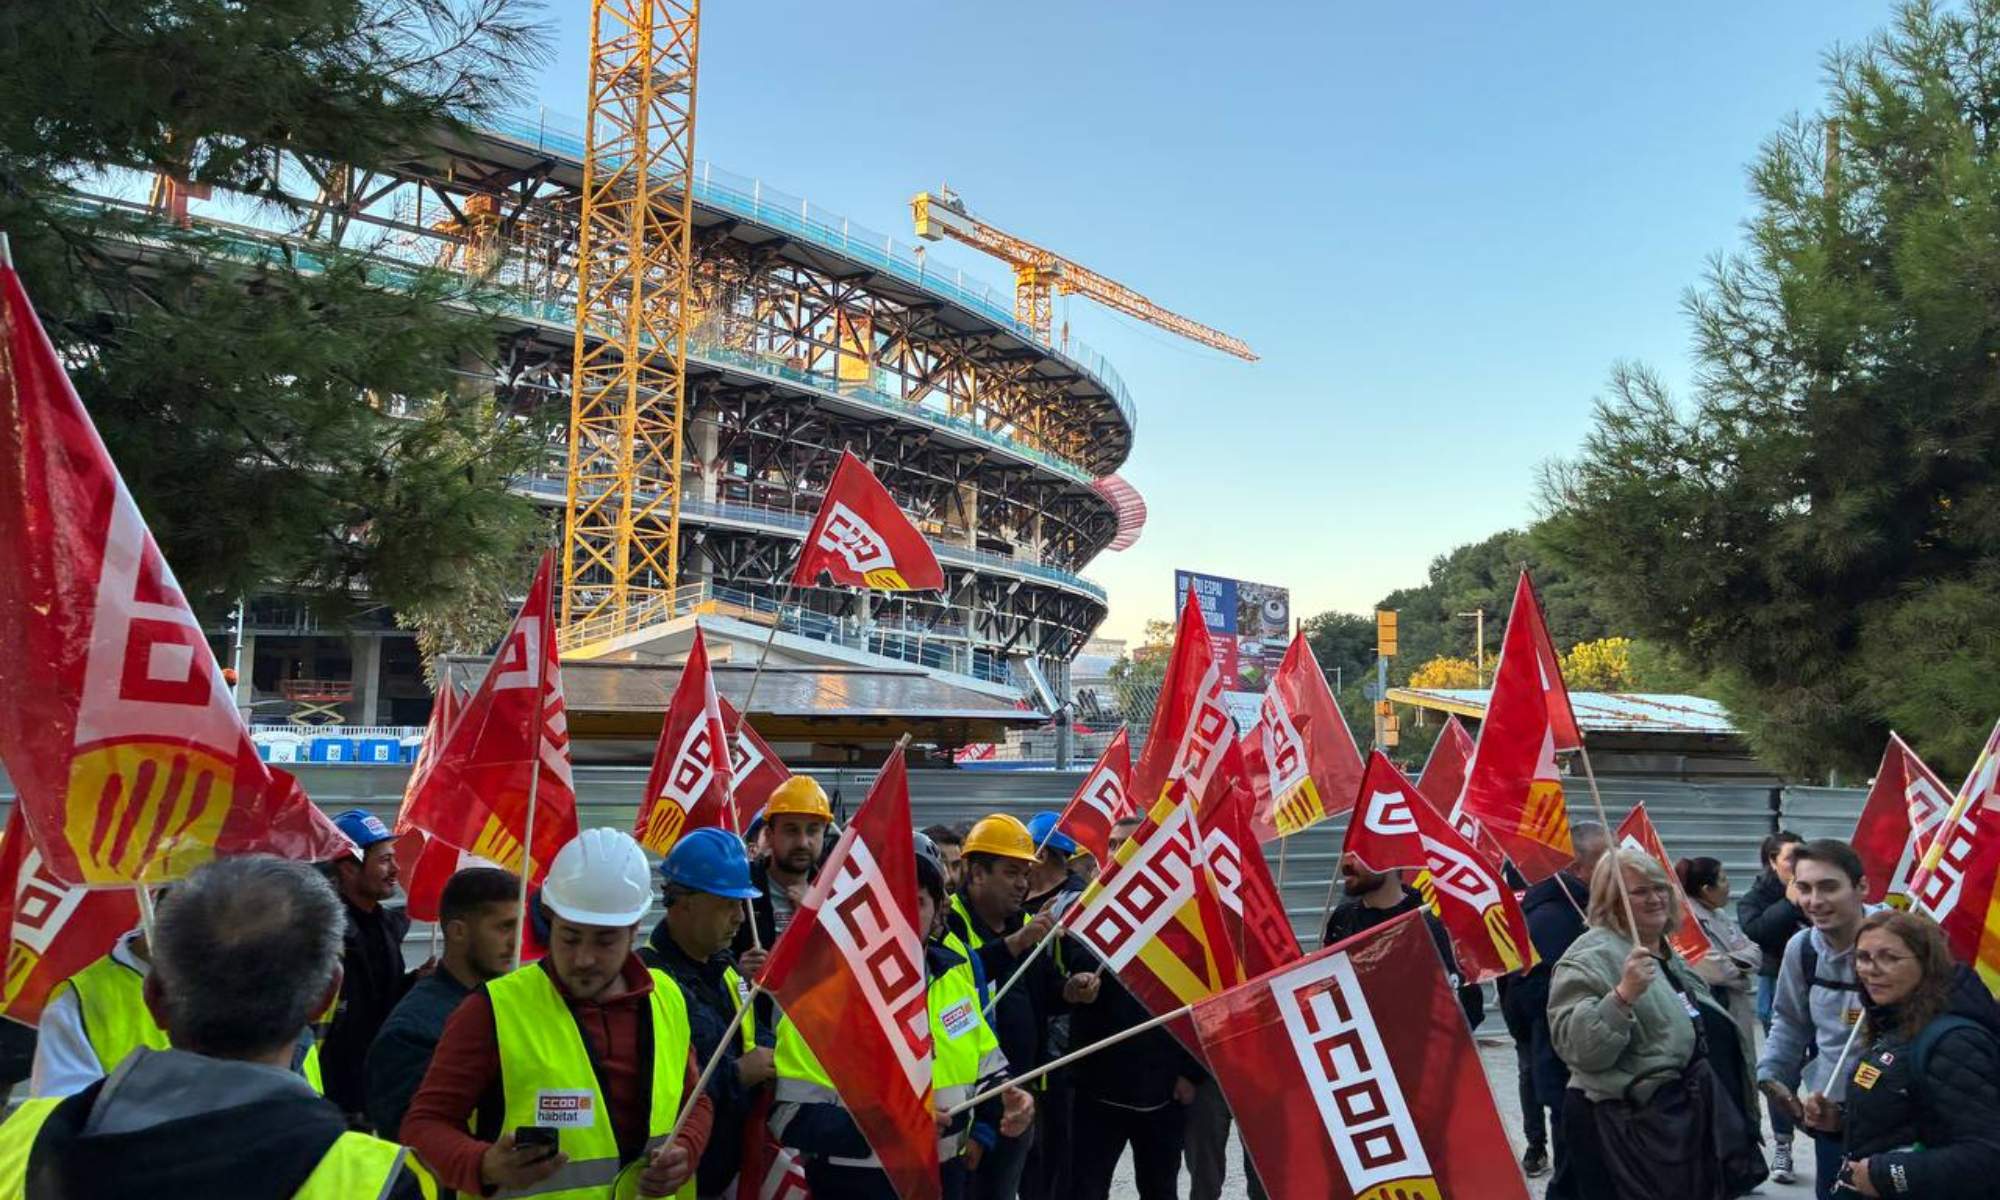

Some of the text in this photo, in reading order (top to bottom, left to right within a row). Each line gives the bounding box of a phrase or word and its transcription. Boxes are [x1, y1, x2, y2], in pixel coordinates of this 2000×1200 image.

[1292, 974, 1408, 1171] CCOO
[542, 1098, 577, 1108] CCOO
[537, 1111, 578, 1122] habitat
